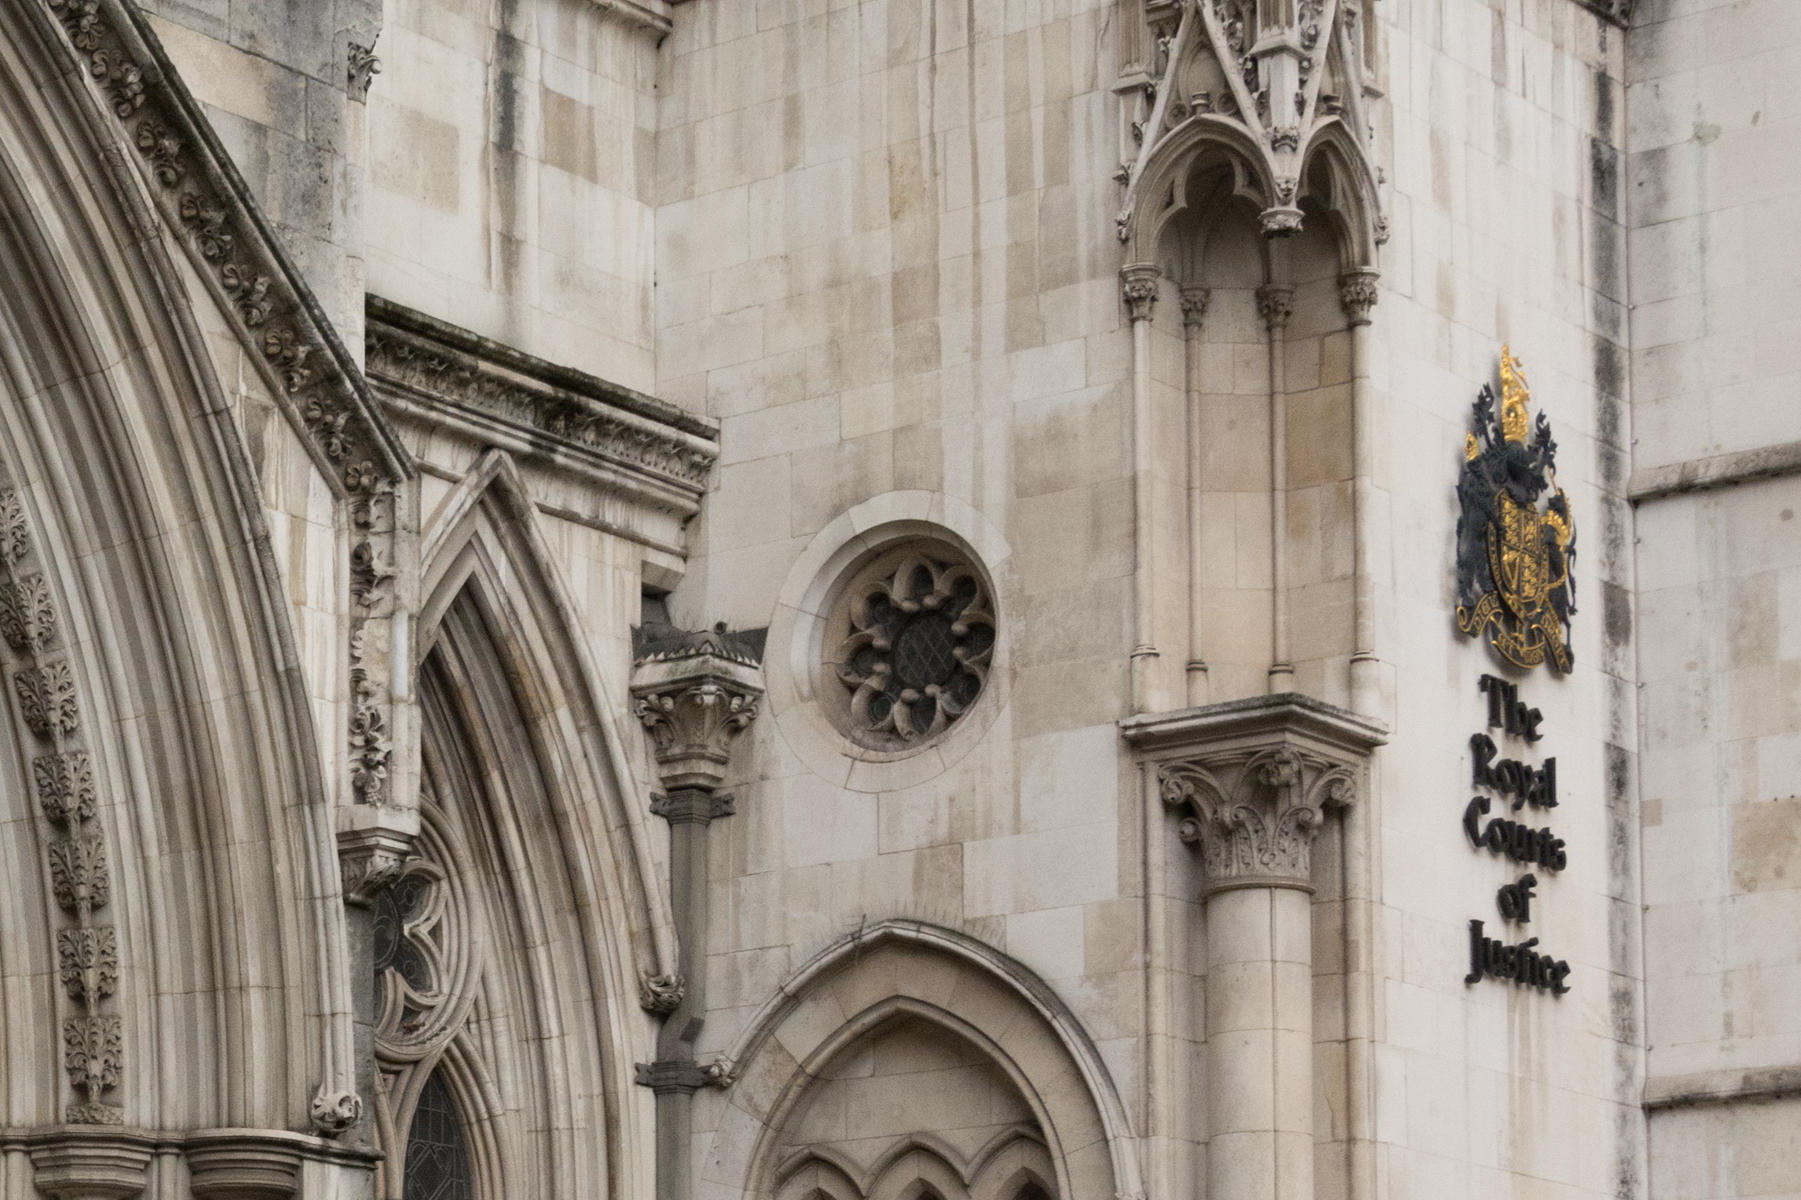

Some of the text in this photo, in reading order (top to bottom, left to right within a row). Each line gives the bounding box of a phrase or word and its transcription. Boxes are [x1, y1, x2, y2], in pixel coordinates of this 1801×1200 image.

[1479, 674, 1544, 742] The
[1470, 733, 1559, 810] Royal
[1463, 796, 1567, 871] Courts
[1497, 873, 1537, 923] of
[1464, 919, 1571, 994] Justice
